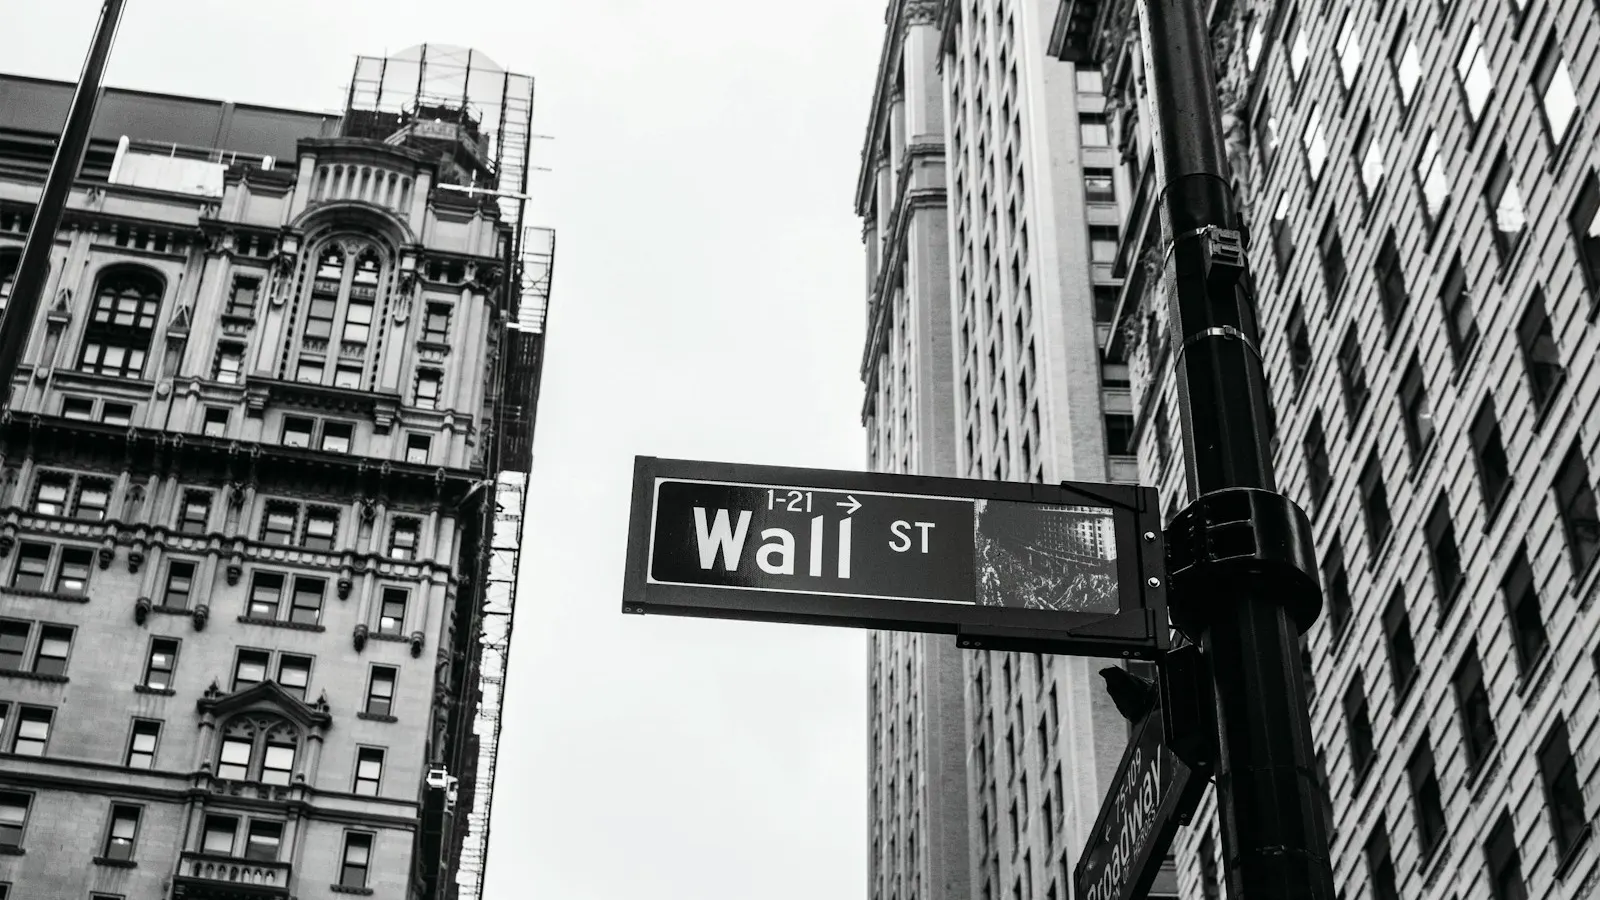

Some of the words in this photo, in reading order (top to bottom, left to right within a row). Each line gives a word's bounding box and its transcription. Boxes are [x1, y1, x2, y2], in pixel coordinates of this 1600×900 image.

[767, 489, 813, 513] 1-21
[693, 506, 852, 579] Wall
[888, 520, 936, 554] ST
[1115, 747, 1142, 823] 75-109
